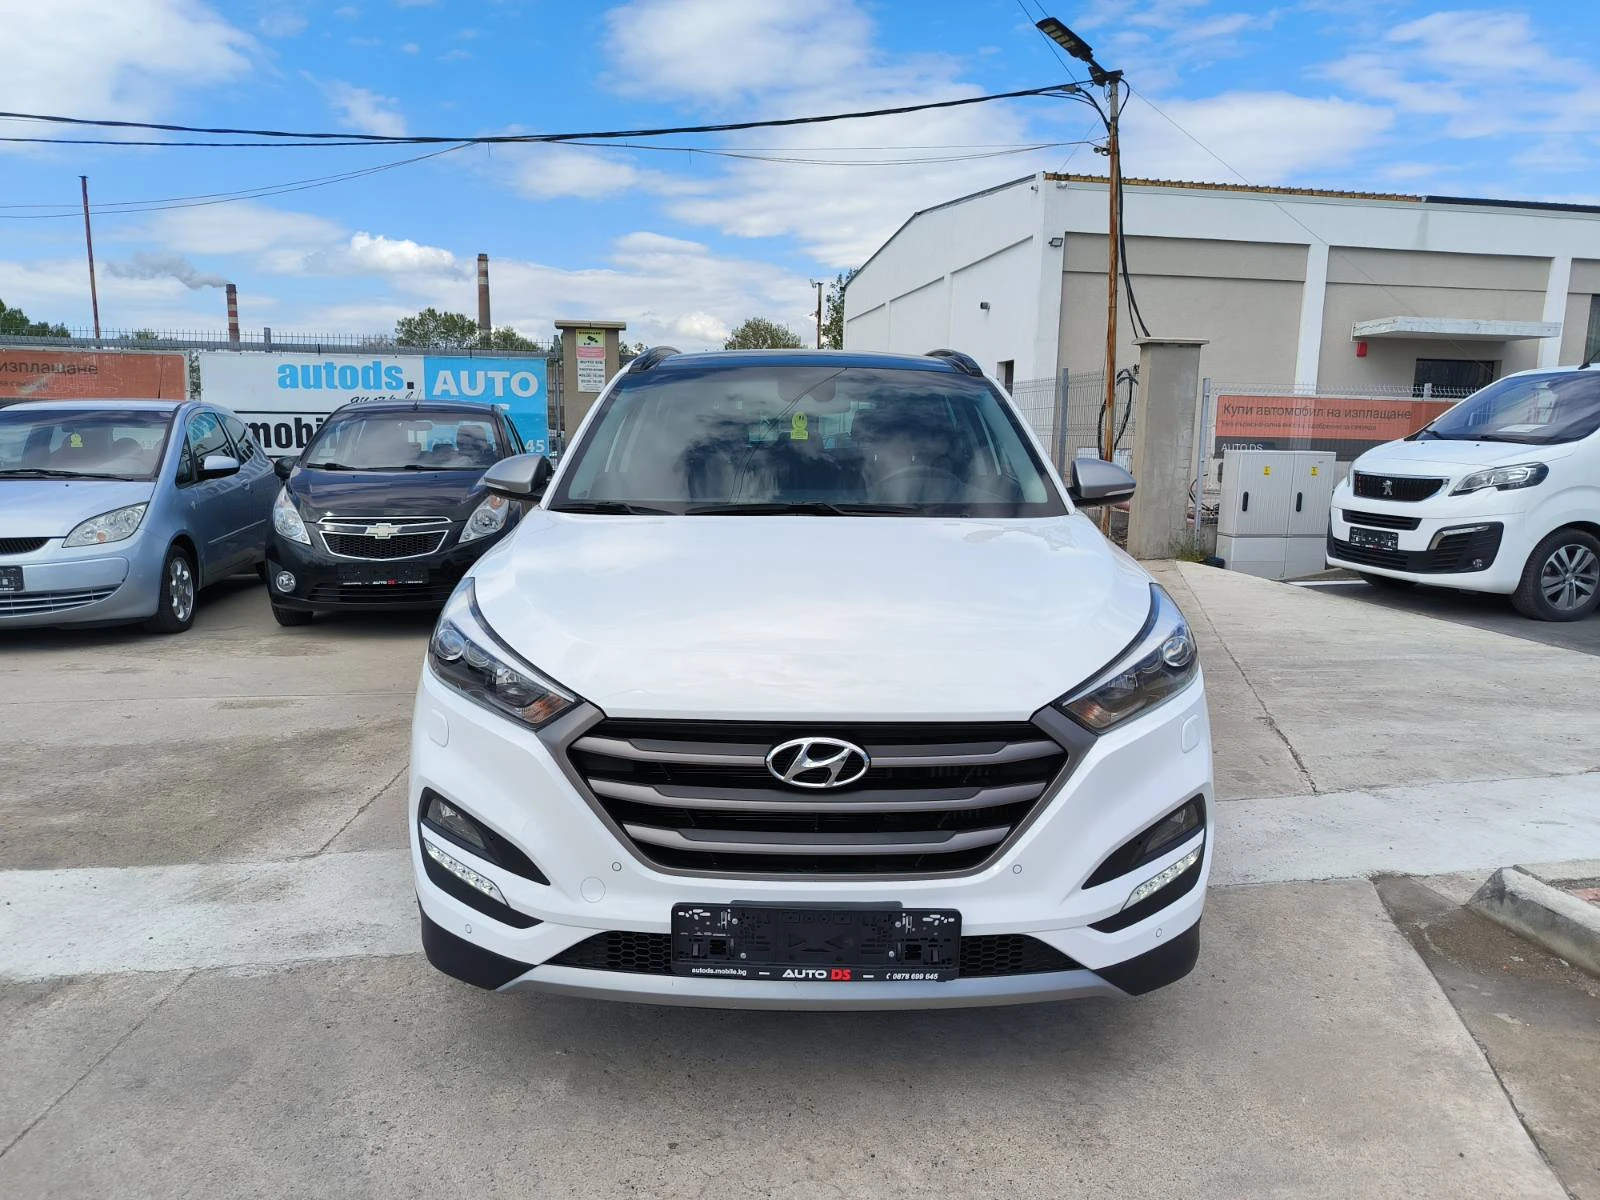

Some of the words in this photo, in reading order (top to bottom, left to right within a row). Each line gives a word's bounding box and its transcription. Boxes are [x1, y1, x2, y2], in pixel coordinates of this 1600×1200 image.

[432, 370, 539, 398] AUTO
[1223, 402, 1253, 418] Купи
[1256, 404, 1324, 417] автомобил
[1327, 408, 1341, 418] на
[1345, 408, 1413, 420] изплащане
[782, 968, 827, 979] AUTO
[831, 968, 852, 980] DS
